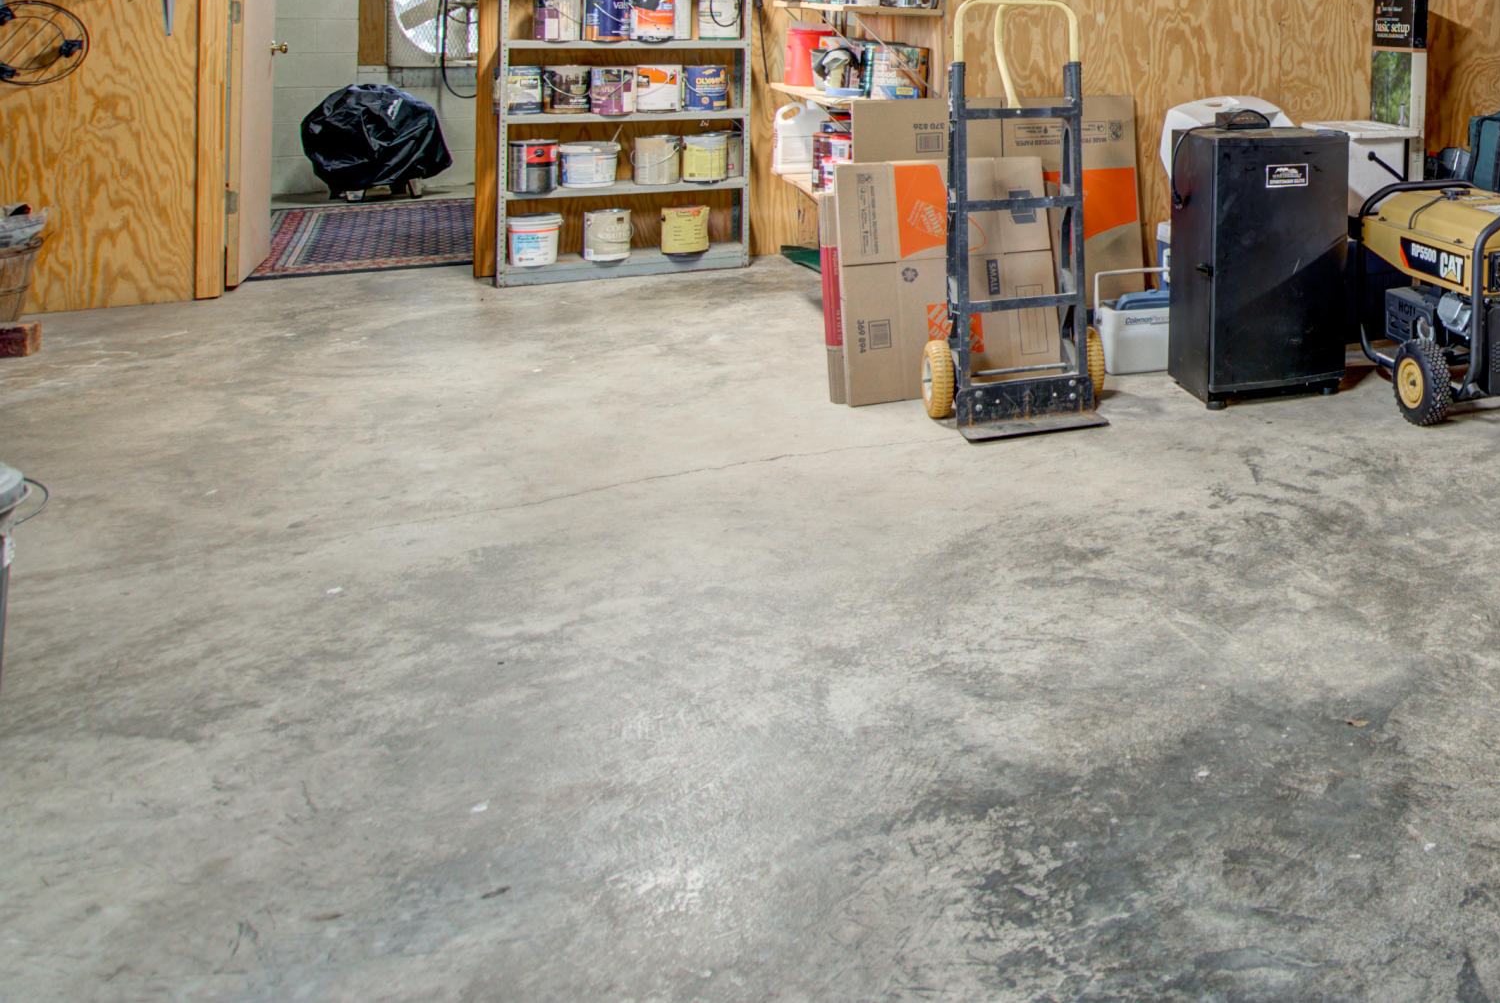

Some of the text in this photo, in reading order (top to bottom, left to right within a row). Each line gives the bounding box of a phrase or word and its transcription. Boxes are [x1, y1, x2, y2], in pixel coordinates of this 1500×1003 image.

[1391, 23, 1410, 37] setup
[988, 262, 999, 293] SMALL
[1411, 242, 1464, 284] RP5500 CAT
